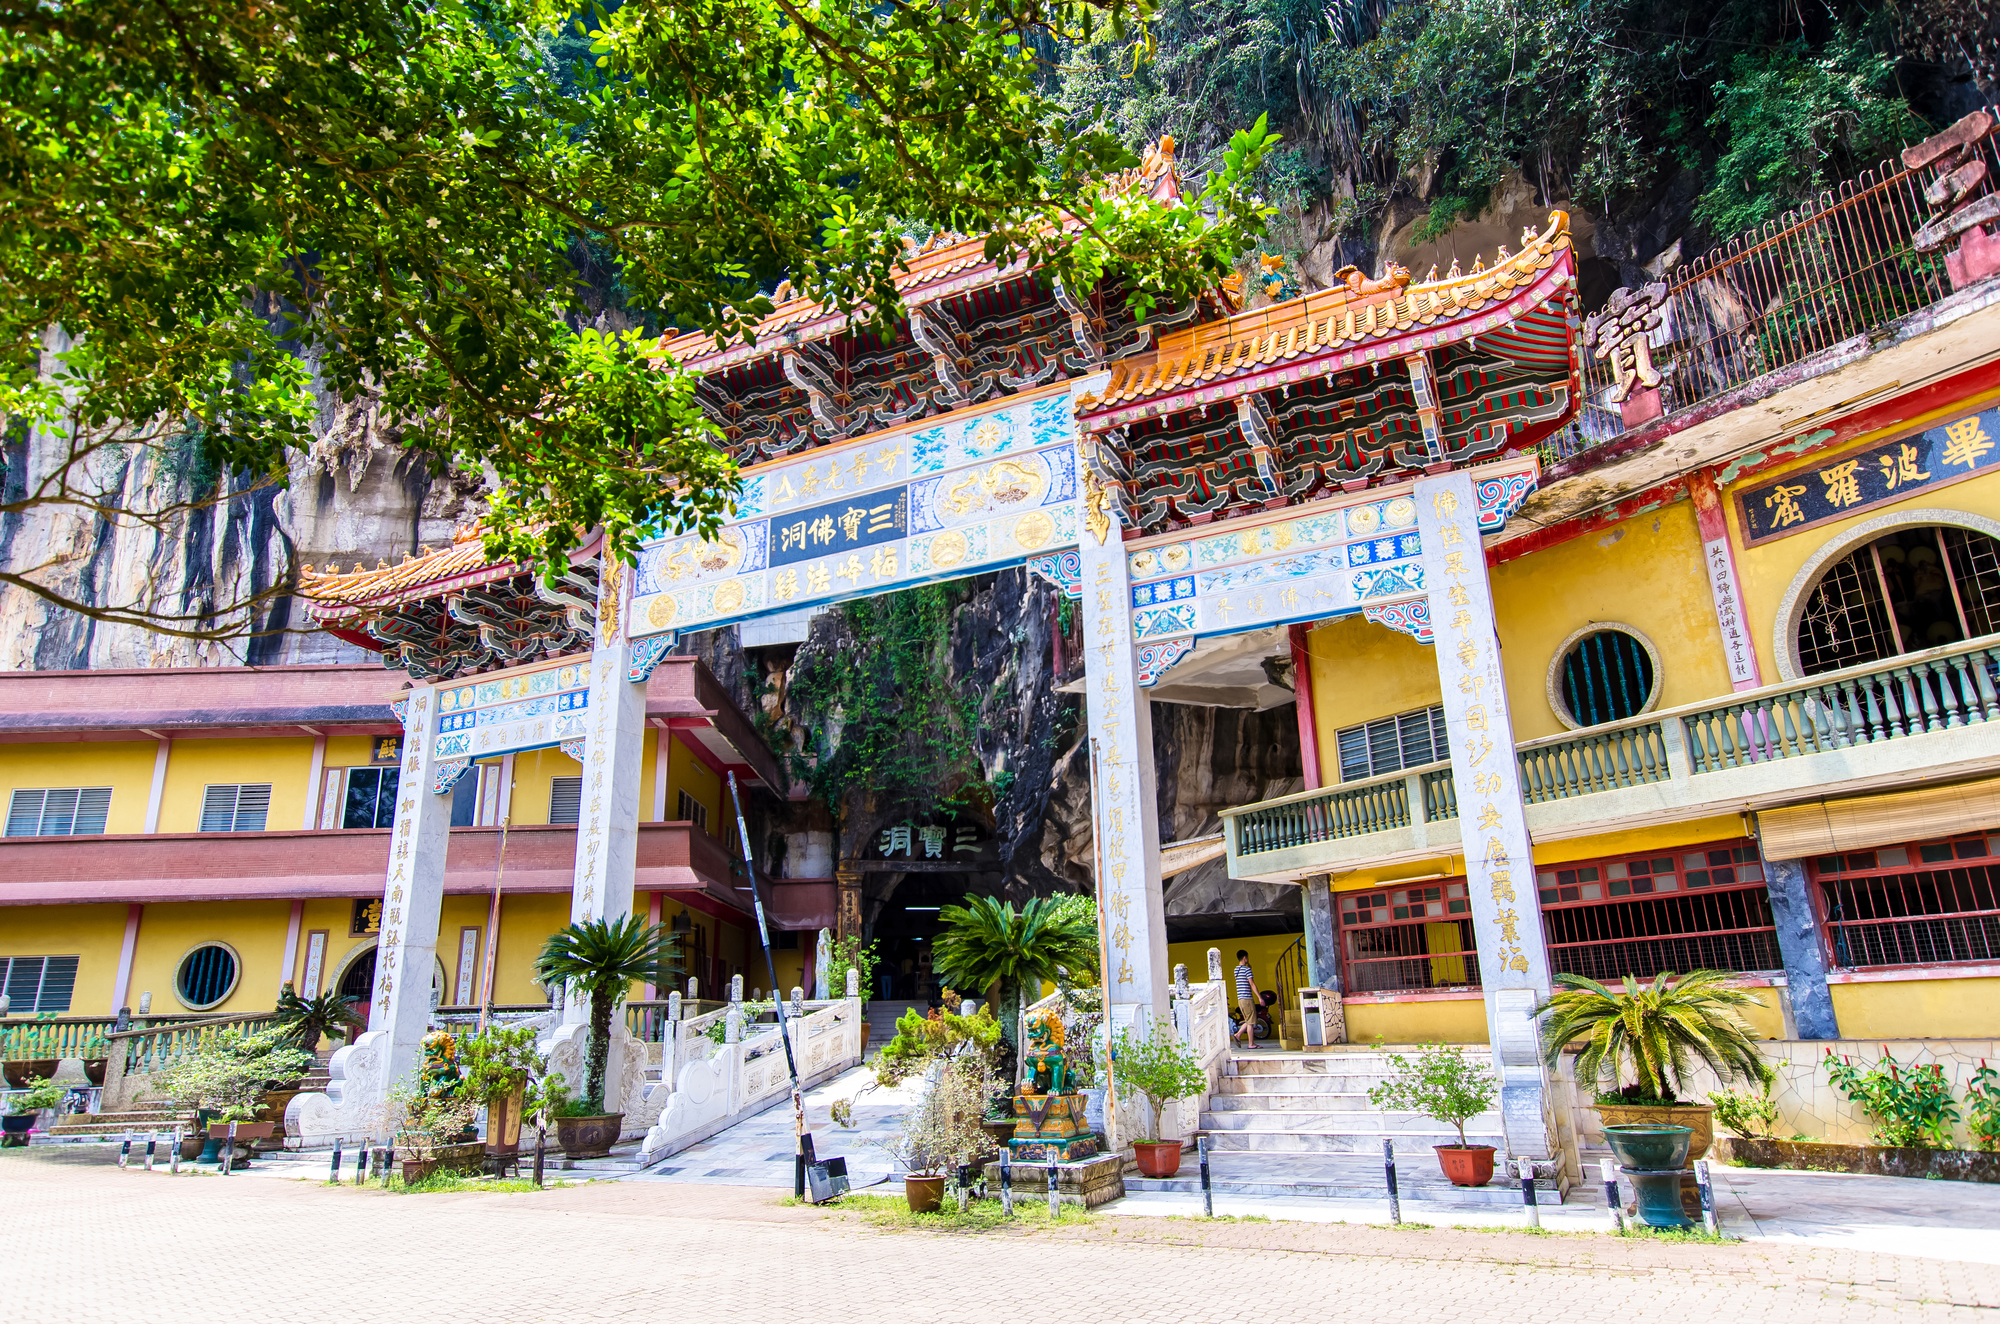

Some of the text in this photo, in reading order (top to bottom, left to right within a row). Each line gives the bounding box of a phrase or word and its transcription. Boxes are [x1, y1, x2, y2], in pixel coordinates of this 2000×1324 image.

[1765, 416, 1996, 529] 畢波羅窟
[781, 503, 894, 552] 三寶佛洞
[774, 546, 899, 601] 梅峰法緣
[1215, 585, 1334, 624] 入佛境界
[378, 738, 397, 758] 殿
[878, 825, 983, 859] 三寶洞
